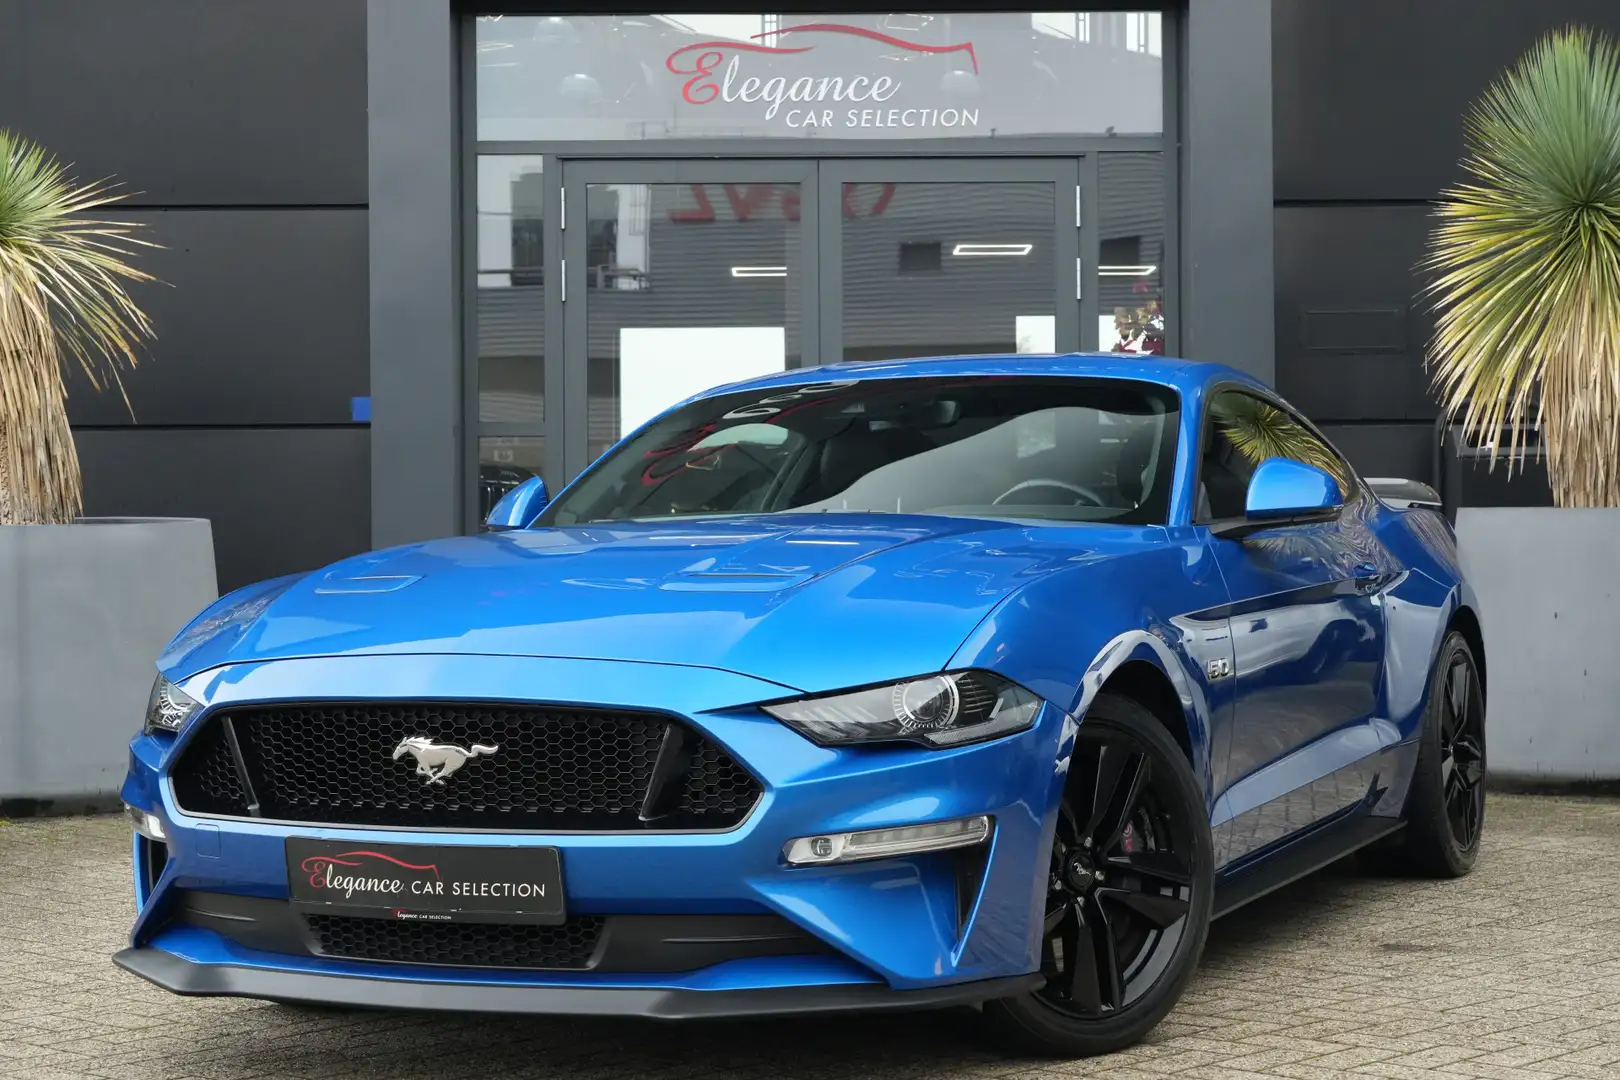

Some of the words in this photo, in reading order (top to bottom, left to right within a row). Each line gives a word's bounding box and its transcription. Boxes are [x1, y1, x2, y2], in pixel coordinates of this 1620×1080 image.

[667, 43, 901, 120] Elegance
[785, 109, 833, 127] CAR
[846, 109, 979, 127] SELECTION
[302, 857, 404, 898] Elegance
[411, 881, 444, 895] CAR
[452, 883, 545, 897] SELECTION
